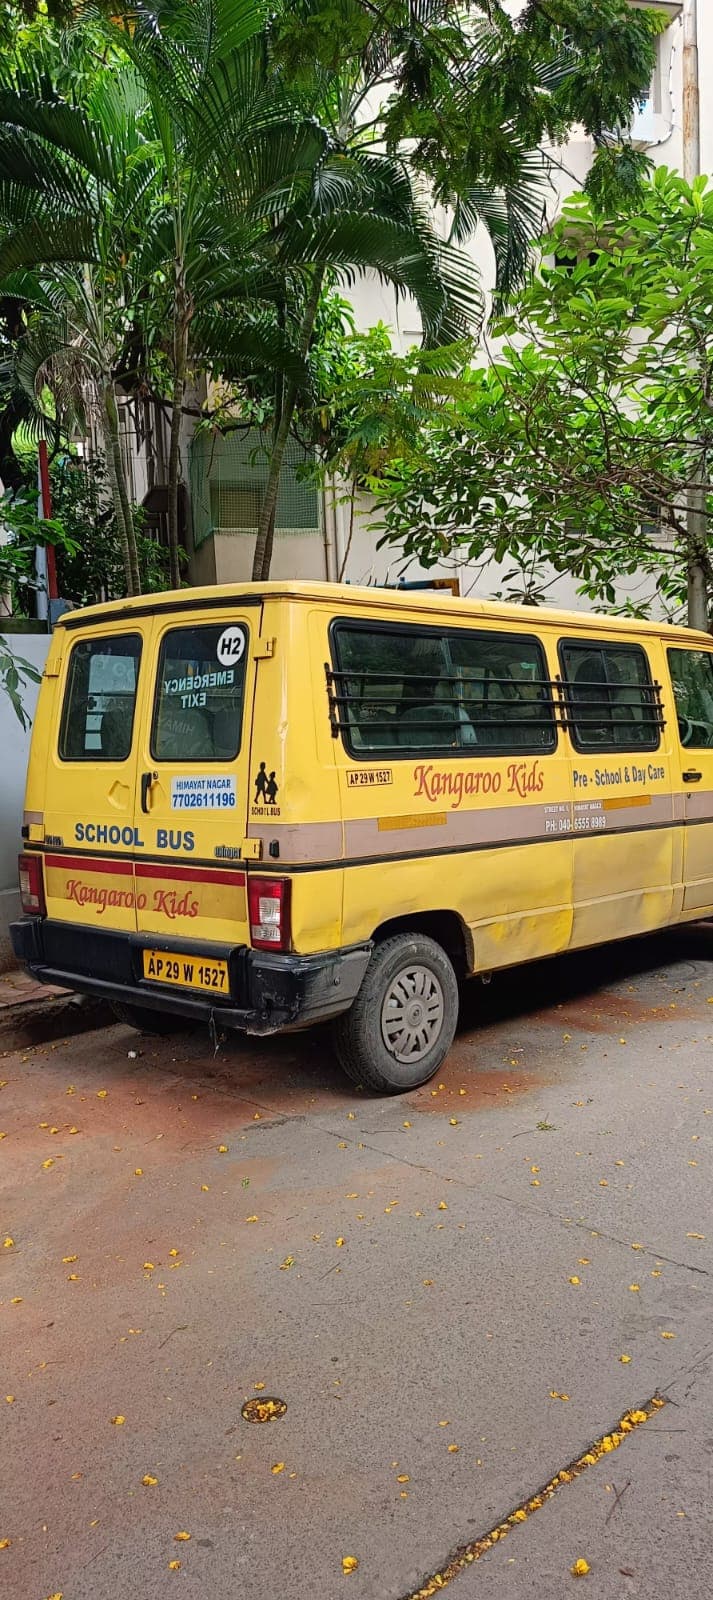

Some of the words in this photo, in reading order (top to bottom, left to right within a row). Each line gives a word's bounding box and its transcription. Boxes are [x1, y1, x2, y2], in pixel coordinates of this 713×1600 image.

[220, 637, 241, 655] H2
[176, 780, 205, 790] HIMAYAT
[207, 779, 231, 789] NAGAR
[350, 773, 358, 784] AP
[360, 772, 368, 784] 29
[369, 772, 375, 783] W
[376, 771, 390, 782] 1527
[413, 764, 502, 808] Kangaroo
[507, 760, 544, 798] Kids
[573, 770, 588, 787] Pre
[595, 768, 622, 786] School
[624, 766, 630, 782] &
[632, 765, 646, 785] Day
[648, 764, 665, 780] Care
[172, 793, 235, 807] 7702611196
[271, 807, 280, 816] BUS
[545, 820, 557, 832] PH:
[75, 823, 144, 846] SCHOOL
[157, 829, 195, 850] BUS
[66, 880, 147, 914] Kangaroo
[153, 890, 199, 919] Kids
[148, 959, 163, 976] AP
[166, 961, 179, 979] 29
[183, 964, 194, 983] W
[198, 966, 226, 988] 1527
